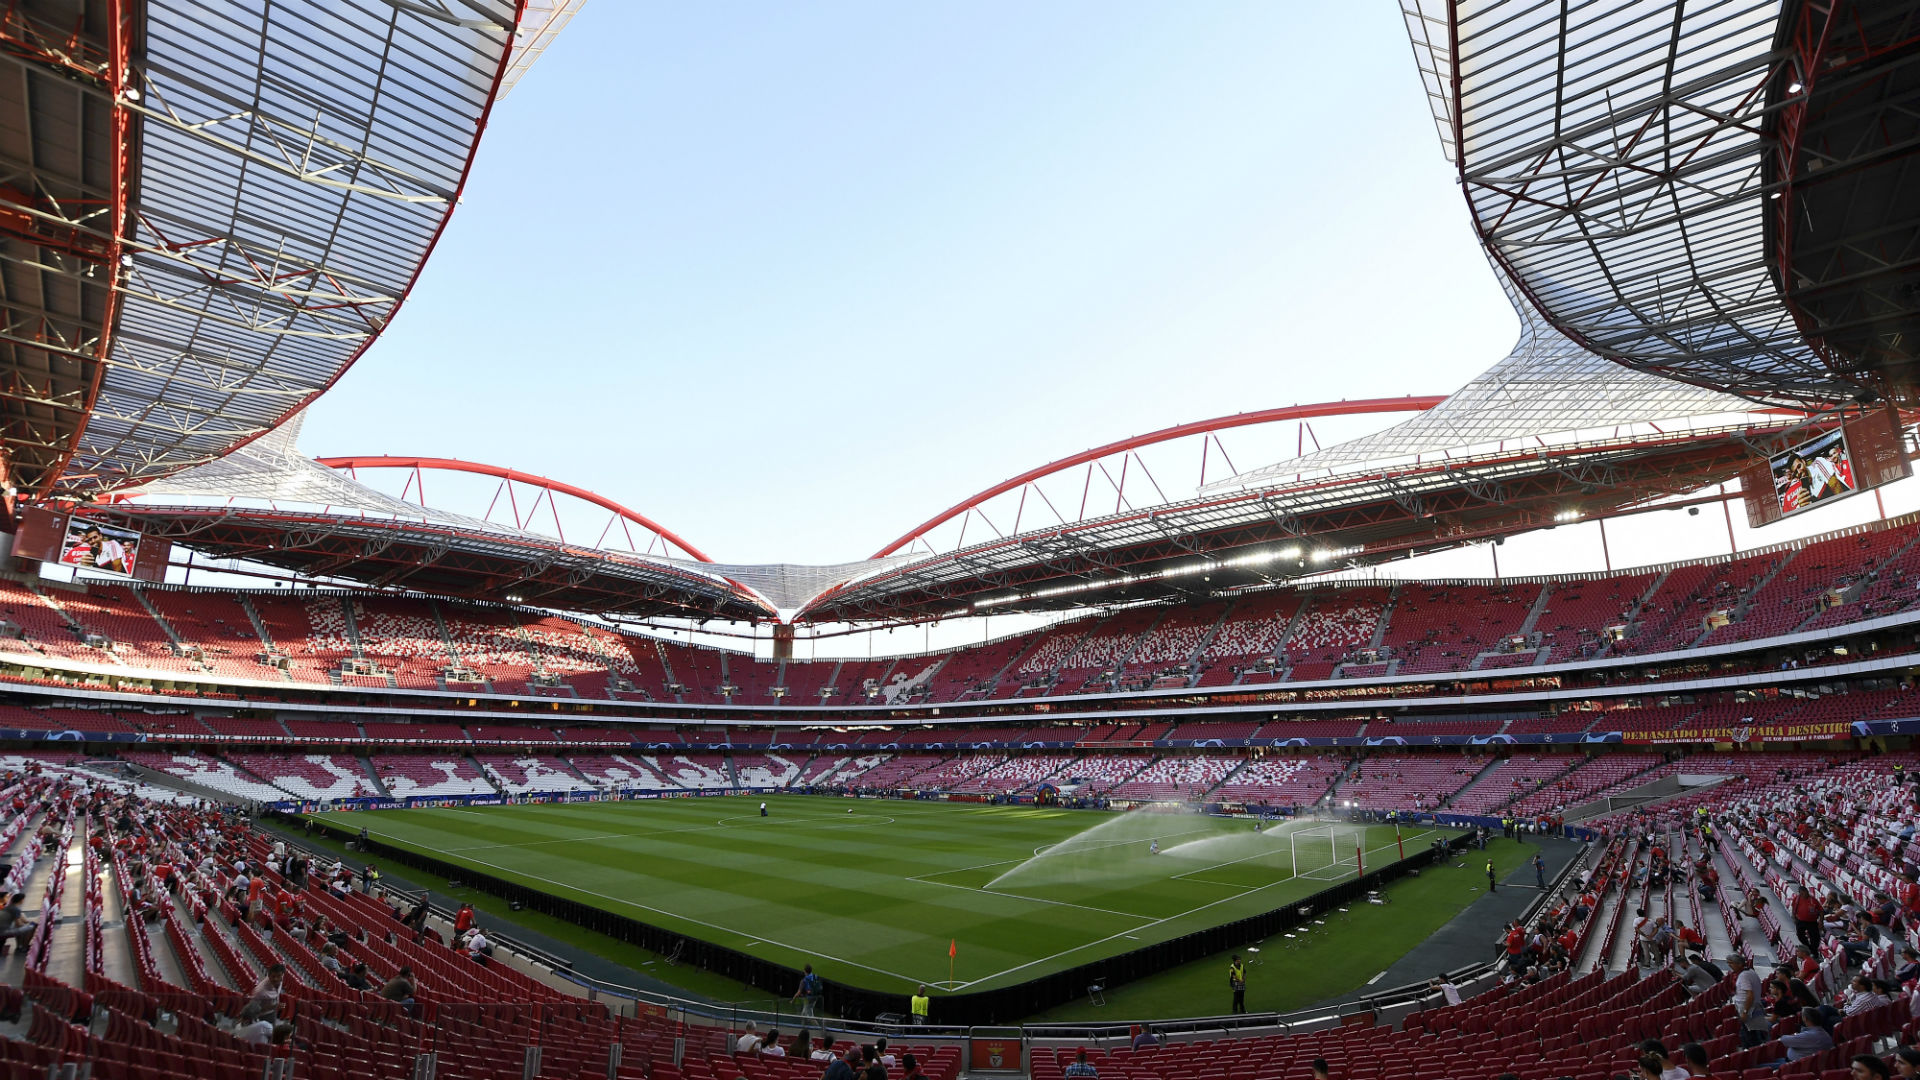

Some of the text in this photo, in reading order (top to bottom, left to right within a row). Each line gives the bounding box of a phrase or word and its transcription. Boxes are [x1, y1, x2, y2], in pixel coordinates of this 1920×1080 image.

[1623, 729, 1698, 740] DEMASIADO
[1748, 726, 1784, 737] PARA
[1787, 722, 1850, 736] DESISTIR!!
